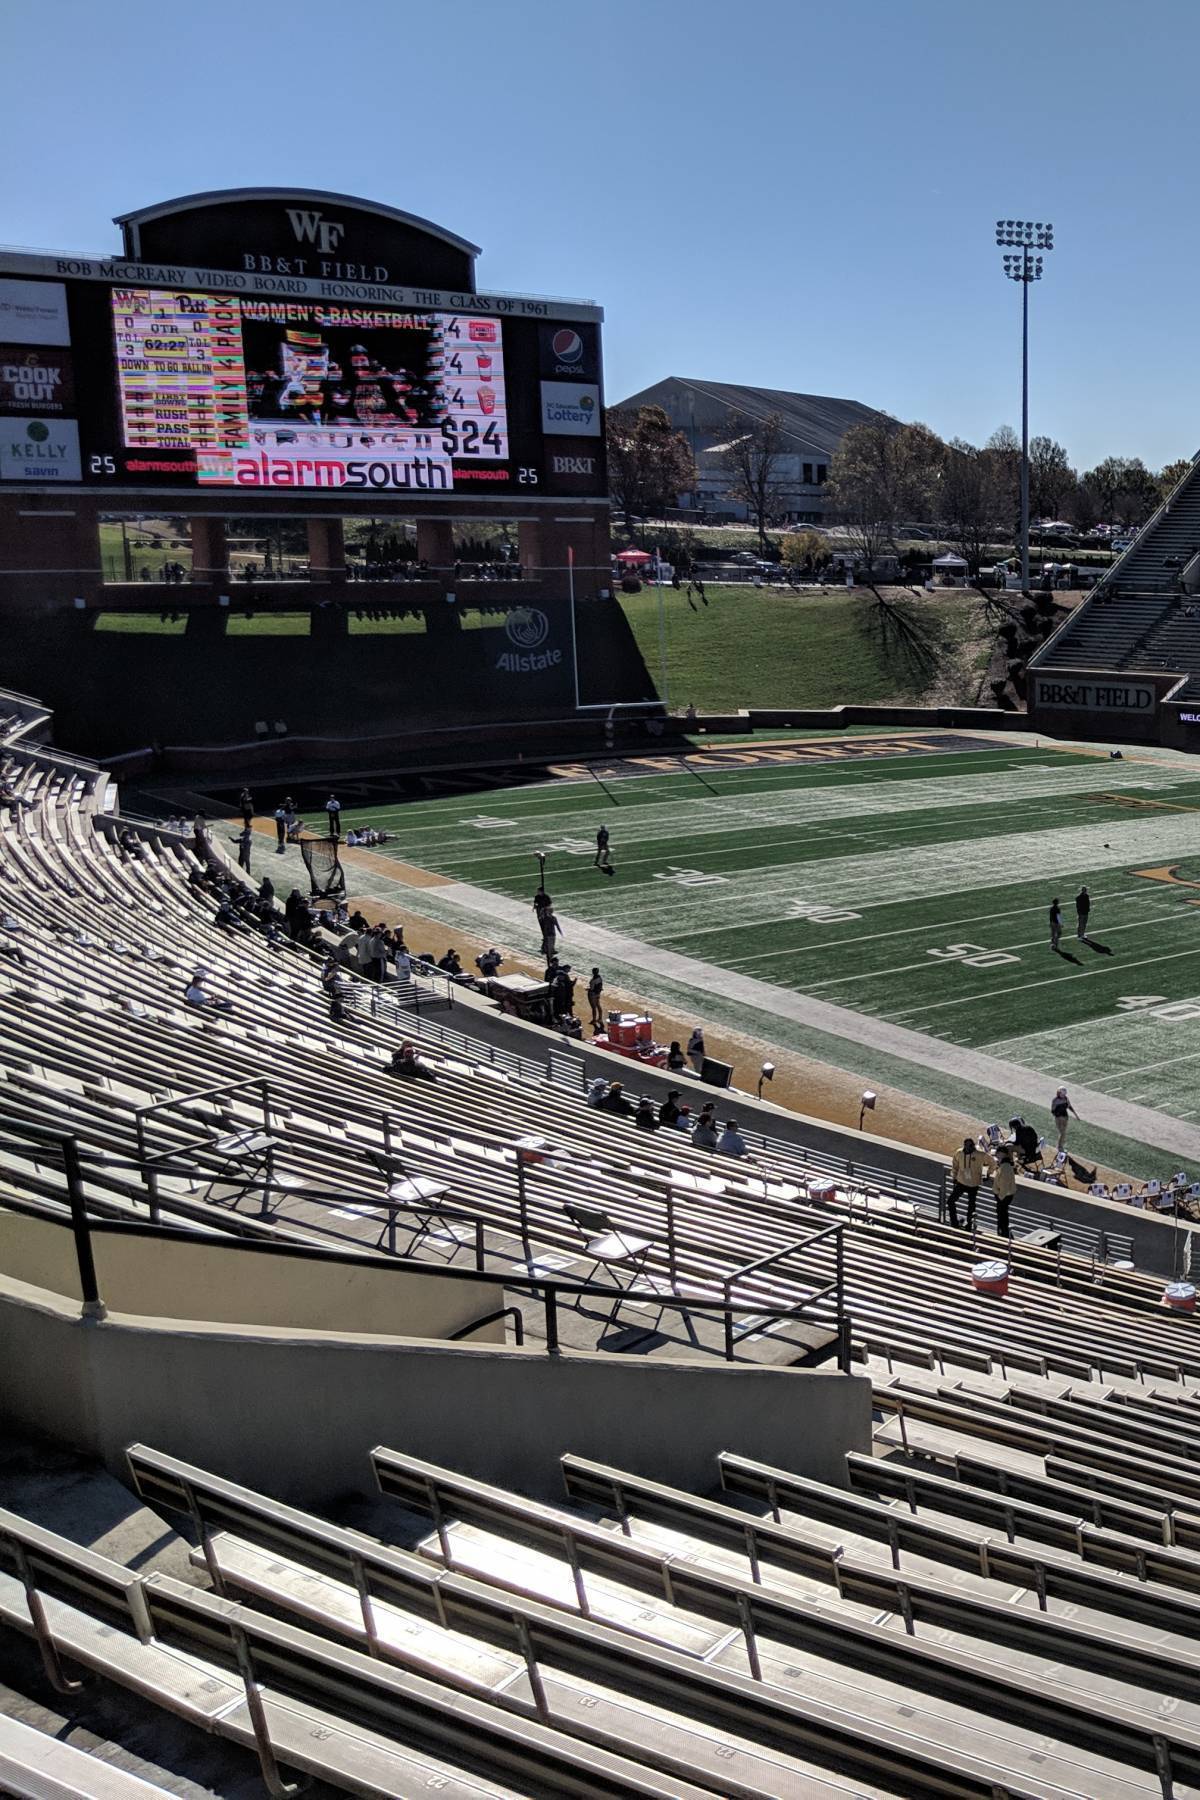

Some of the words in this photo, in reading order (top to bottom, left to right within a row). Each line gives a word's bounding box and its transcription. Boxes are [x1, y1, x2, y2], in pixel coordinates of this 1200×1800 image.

[243, 253, 308, 275] BB&T
[321, 261, 389, 282] FIELD
[56, 260, 92, 276] BOB
[100, 263, 187, 284] McCREARY
[195, 271, 247, 288] VIDEO
[253, 277, 308, 294] BOARD
[321, 283, 404, 302] HONORING
[412, 291, 442, 306] THE
[450, 295, 490, 310] CLASS
[496, 301, 514, 313] OF
[520, 302, 550, 316] 1961
[214, 297, 236, 347] PACK
[241, 300, 324, 323] WOMEN'S
[329, 307, 432, 330] BASKETBALL
[126, 345, 135, 356] 3
[196, 350, 206, 361] 3
[121, 358, 149, 370] DOWN
[154, 361, 166, 372] TO
[167, 361, 178, 372] GO
[182, 362, 202, 373] BALL
[203, 364, 212, 373] ON
[2, 365, 63, 385] COOK
[13, 382, 55, 401] OUT
[155, 409, 188, 420] RUSH
[221, 380, 243, 449] FAMILY
[547, 409, 594, 425] Lottery
[157, 423, 189, 434] PASS
[441, 415, 503, 456] $24
[11, 443, 67, 458] KELLY
[158, 437, 190, 448] TOTAL
[91, 456, 116, 474] 25
[125, 459, 197, 472] alarmsouth
[237, 450, 447, 489] alarmsouth
[554, 456, 596, 474] BB&T
[453, 469, 510, 481] alarmsouth
[518, 468, 538, 484] 25
[495, 649, 562, 673] Allstate
[1039, 683, 1092, 706] BB&T
[1095, 686, 1152, 709] FIELD
[631, 740, 944, 772] FOREST
[926, 943, 1021, 968] 50
[426, 1775, 449, 1789] 22
